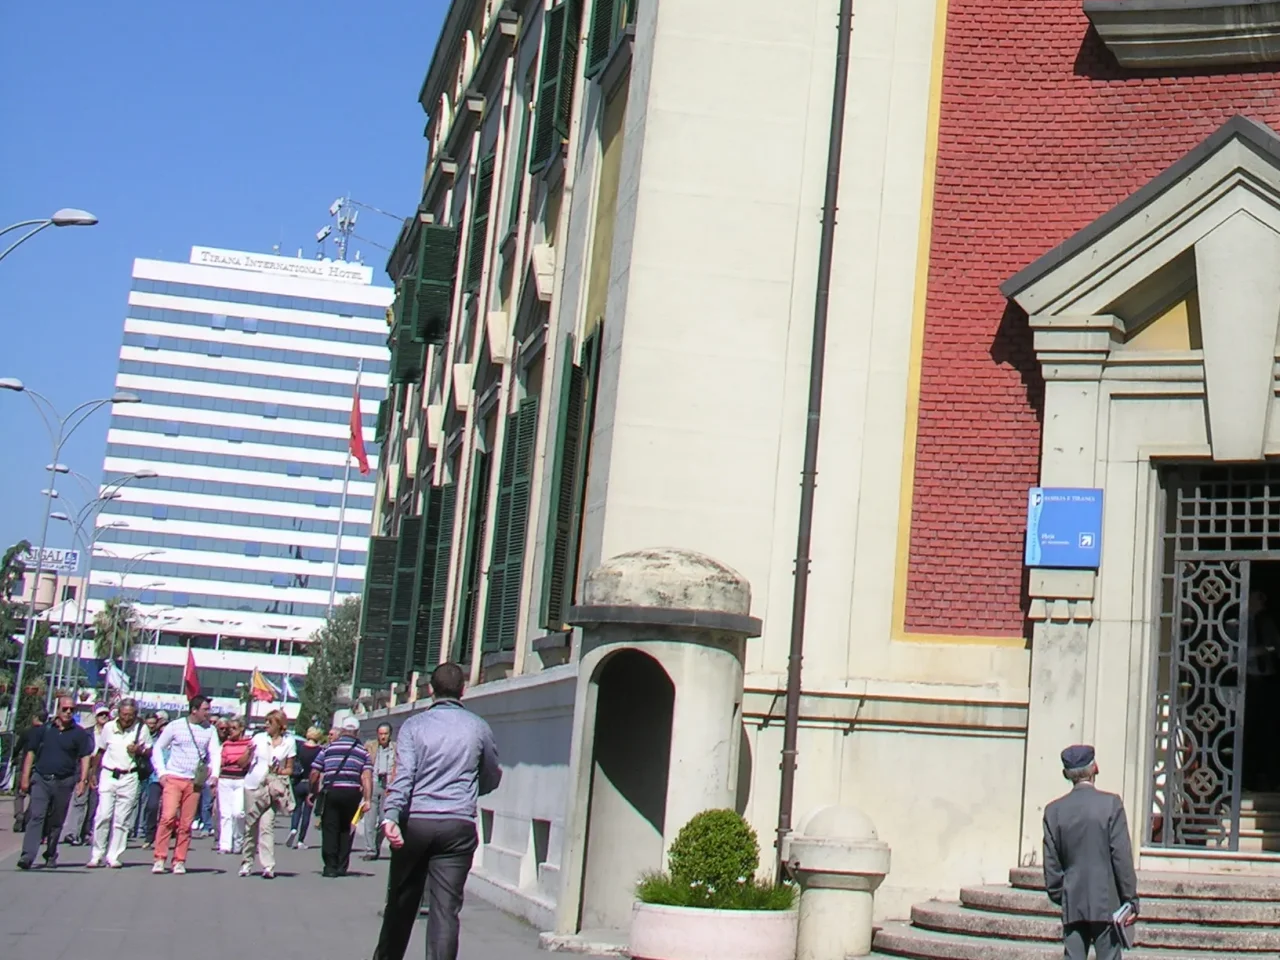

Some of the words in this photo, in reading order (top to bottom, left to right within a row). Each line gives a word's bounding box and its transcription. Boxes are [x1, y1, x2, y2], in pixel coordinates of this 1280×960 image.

[201, 251, 242, 266] TIRANA
[244, 256, 324, 276] INTERNATIONAL
[328, 266, 363, 280] HOTEL
